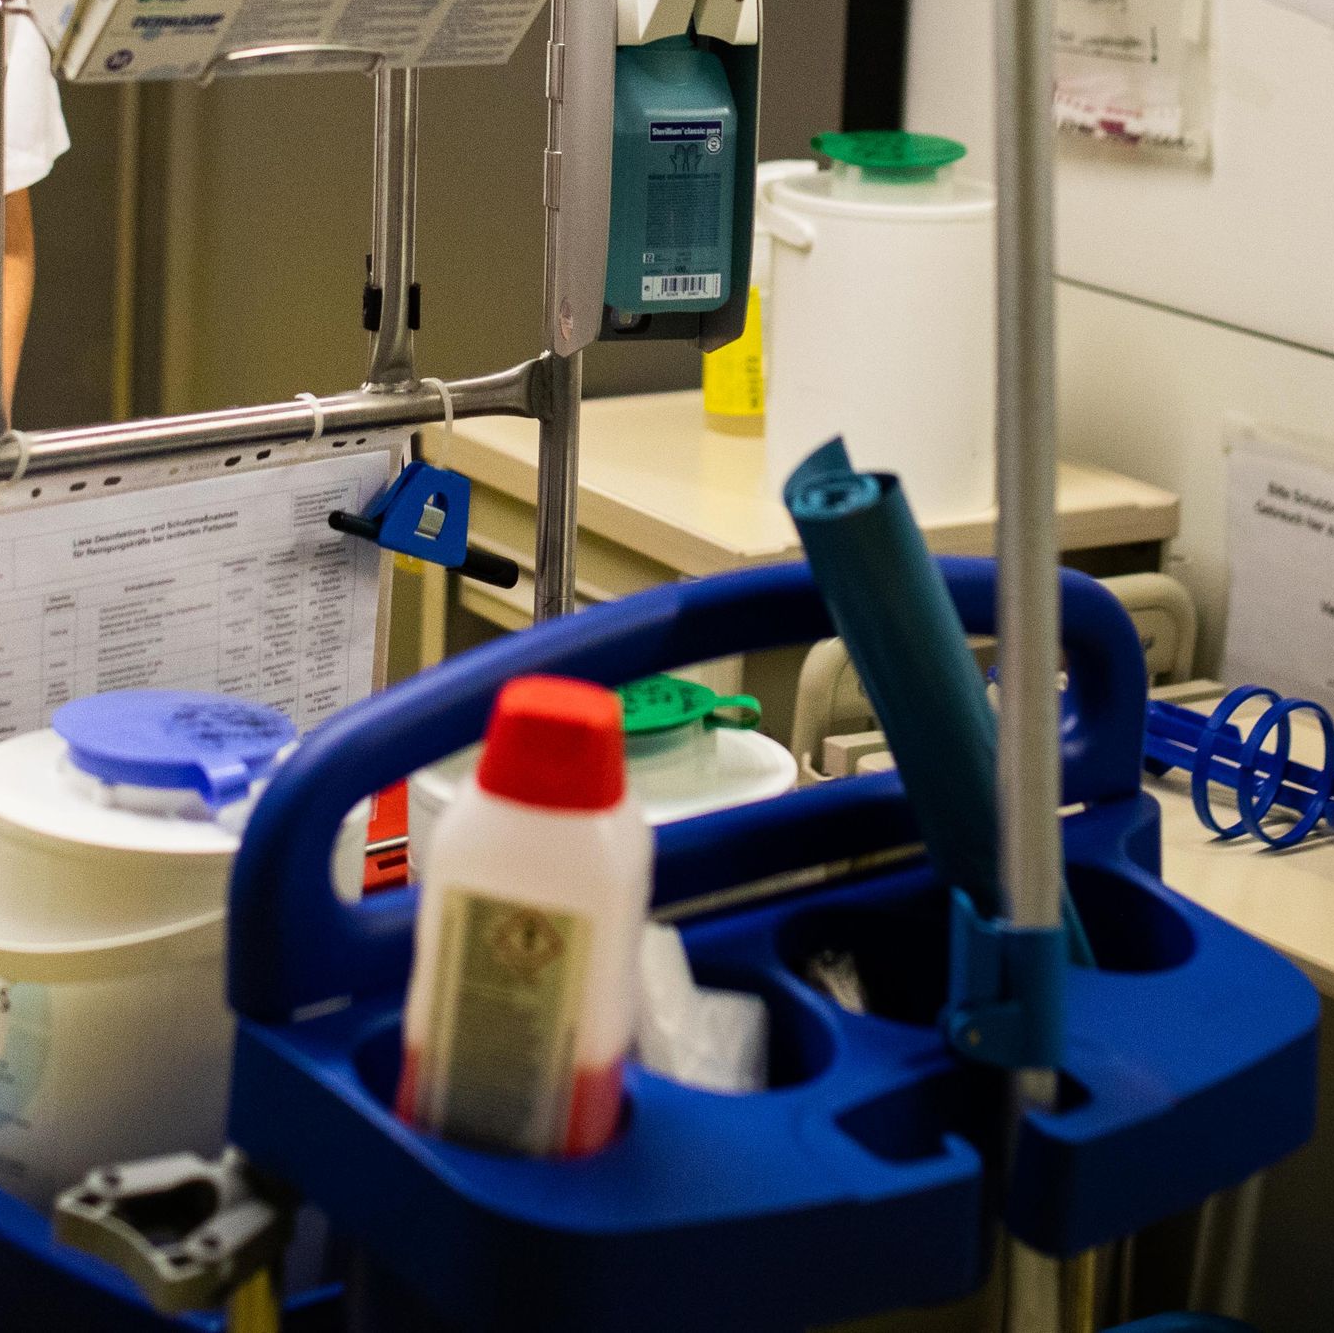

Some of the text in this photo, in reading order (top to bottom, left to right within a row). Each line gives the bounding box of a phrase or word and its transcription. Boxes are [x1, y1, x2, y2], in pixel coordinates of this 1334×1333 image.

[652, 127, 682, 136] Sterillium
[684, 127, 706, 136] classic
[1253, 499, 1303, 527] Gebrauch
[1306, 516, 1325, 533] hier
[151, 522, 166, 533] und
[73, 548, 85, 559] für
[202, 520, 238, 535] Patienten
